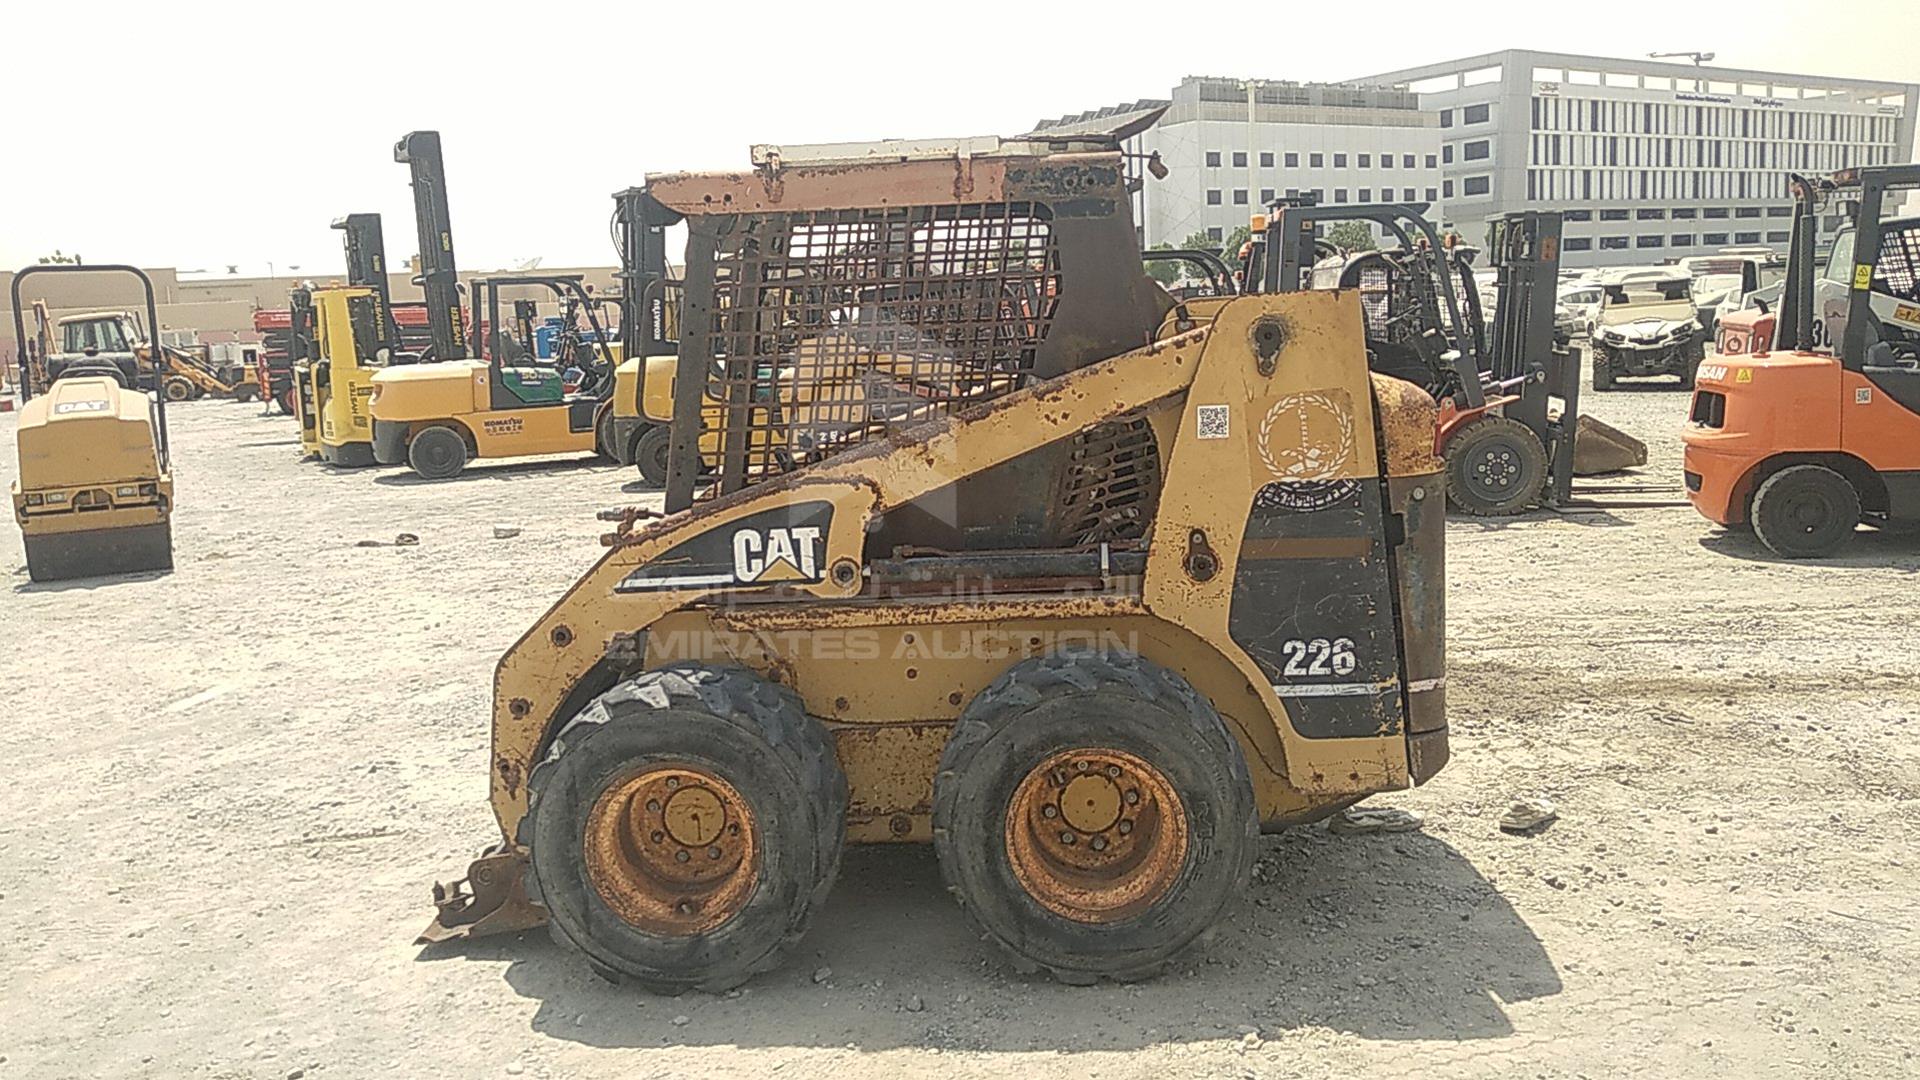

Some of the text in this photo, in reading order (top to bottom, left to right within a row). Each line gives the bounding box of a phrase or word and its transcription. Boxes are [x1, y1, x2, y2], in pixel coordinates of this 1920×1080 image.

[450, 306, 463, 347] HYSTER
[652, 299, 661, 340] KOMATSU
[348, 381, 359, 415] HYSTER
[484, 417, 523, 427] KOMATSU
[733, 526, 821, 582] CAT
[1281, 637, 1357, 677] 226
